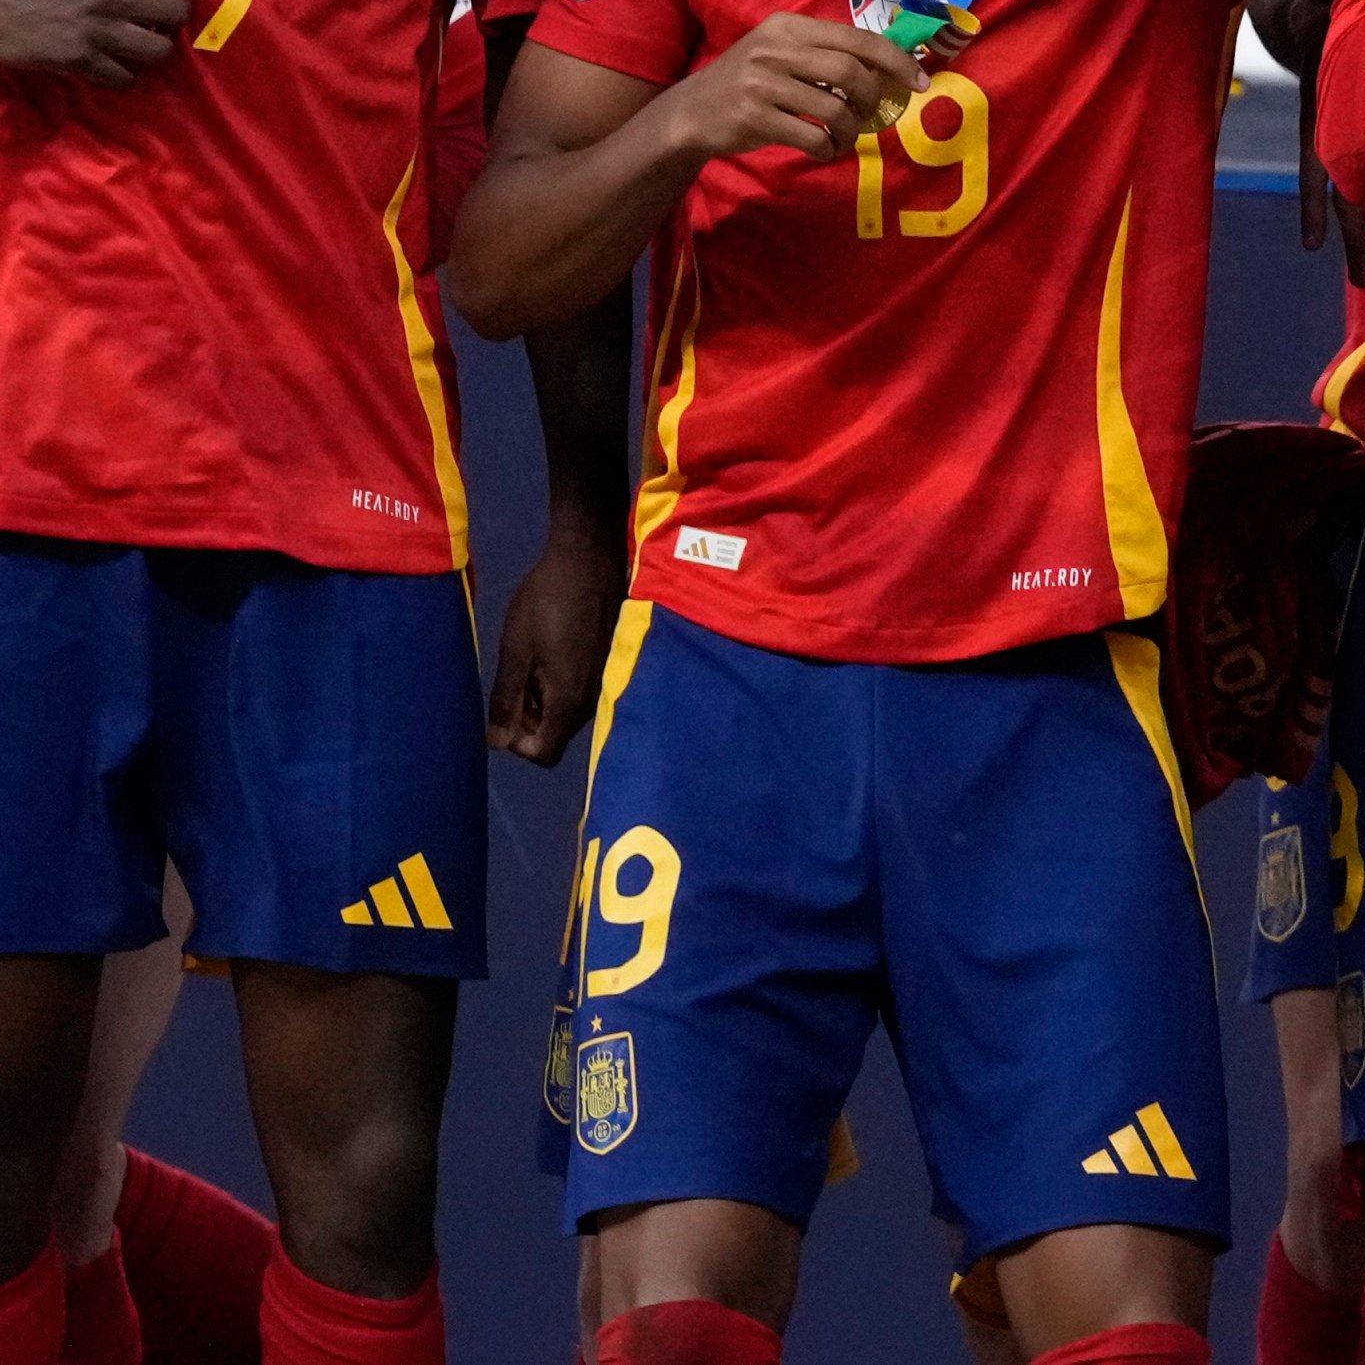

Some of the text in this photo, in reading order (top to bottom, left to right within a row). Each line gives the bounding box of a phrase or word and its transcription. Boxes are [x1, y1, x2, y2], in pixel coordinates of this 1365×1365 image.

[856, 71, 989, 239] 19
[351, 488, 420, 524] HEAT.RDY
[1011, 566, 1093, 592] HEAT.RDY
